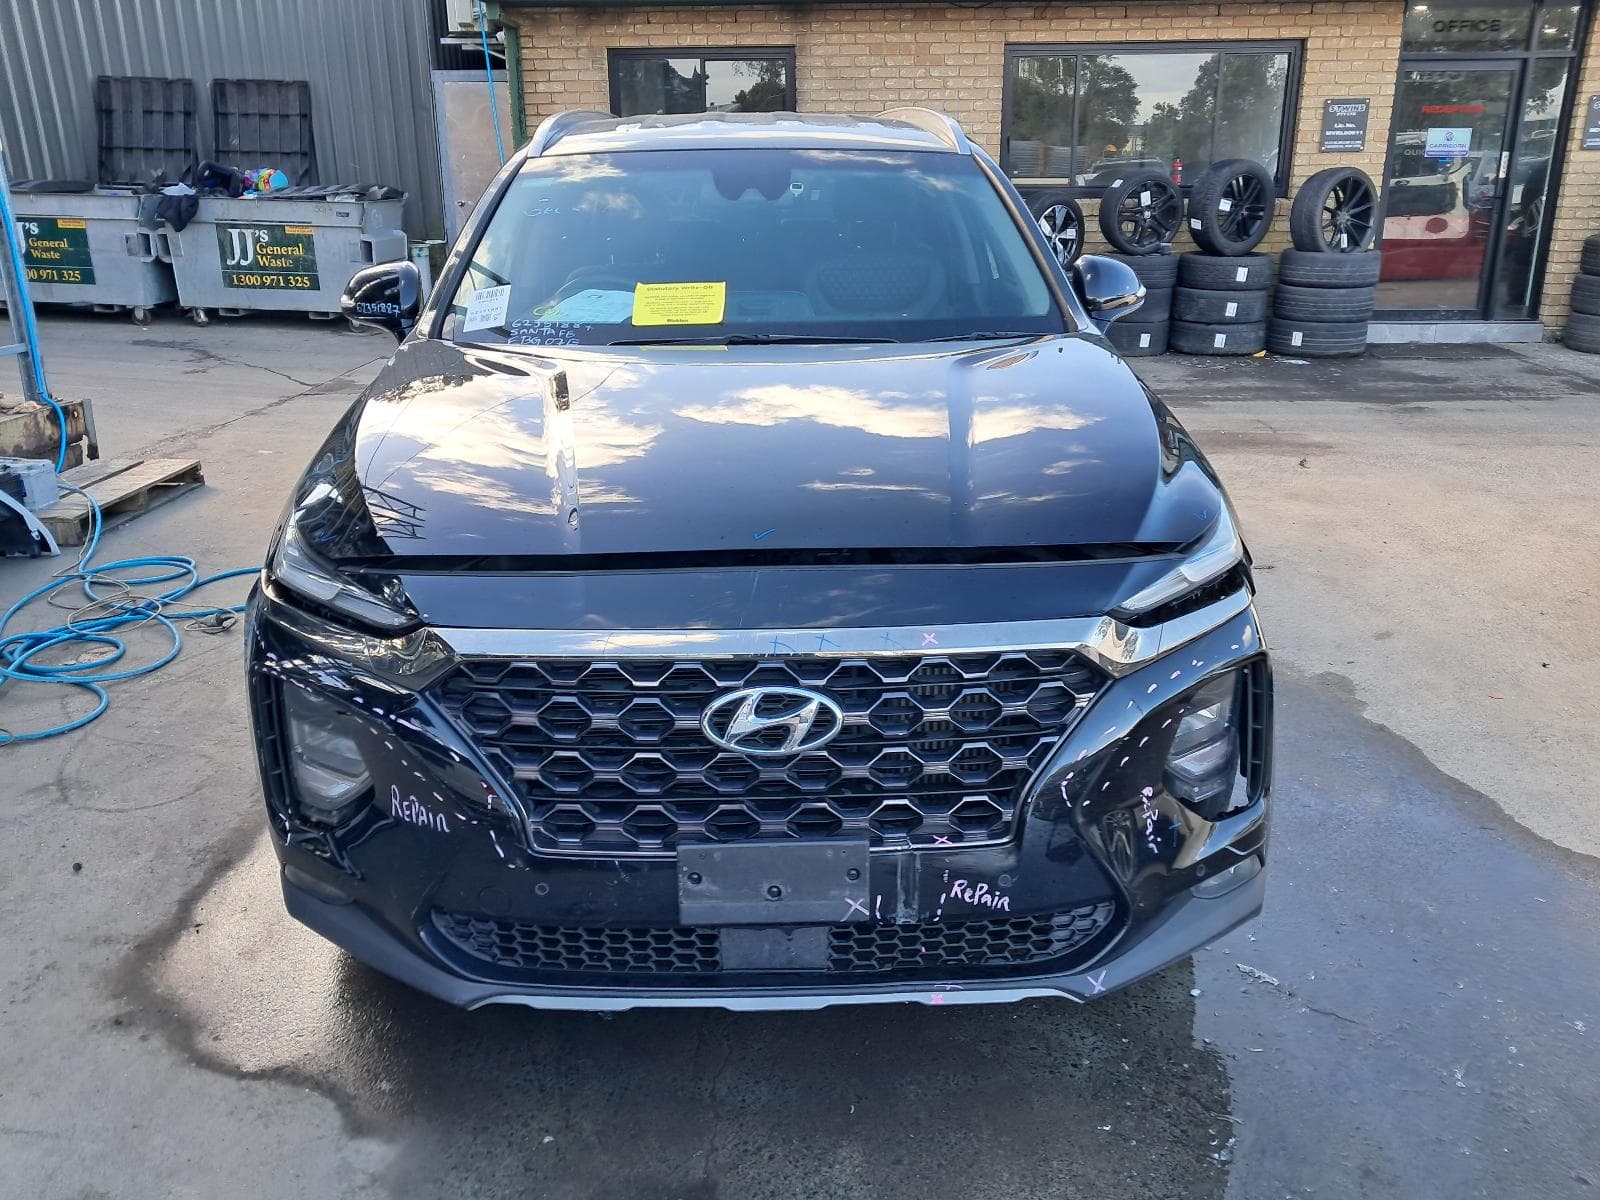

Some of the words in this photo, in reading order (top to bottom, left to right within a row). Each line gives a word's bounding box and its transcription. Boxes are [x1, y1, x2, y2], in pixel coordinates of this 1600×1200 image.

[1433, 20, 1501, 33] OFFICE
[28, 237, 68, 248] General
[256, 242, 303, 255] General
[31, 249, 60, 259] Waste
[256, 255, 293, 267] Waste
[39, 270, 58, 281] 971
[62, 270, 81, 281] 325
[232, 274, 260, 286] 1300
[262, 275, 286, 286] 971
[288, 276, 310, 287] 325
